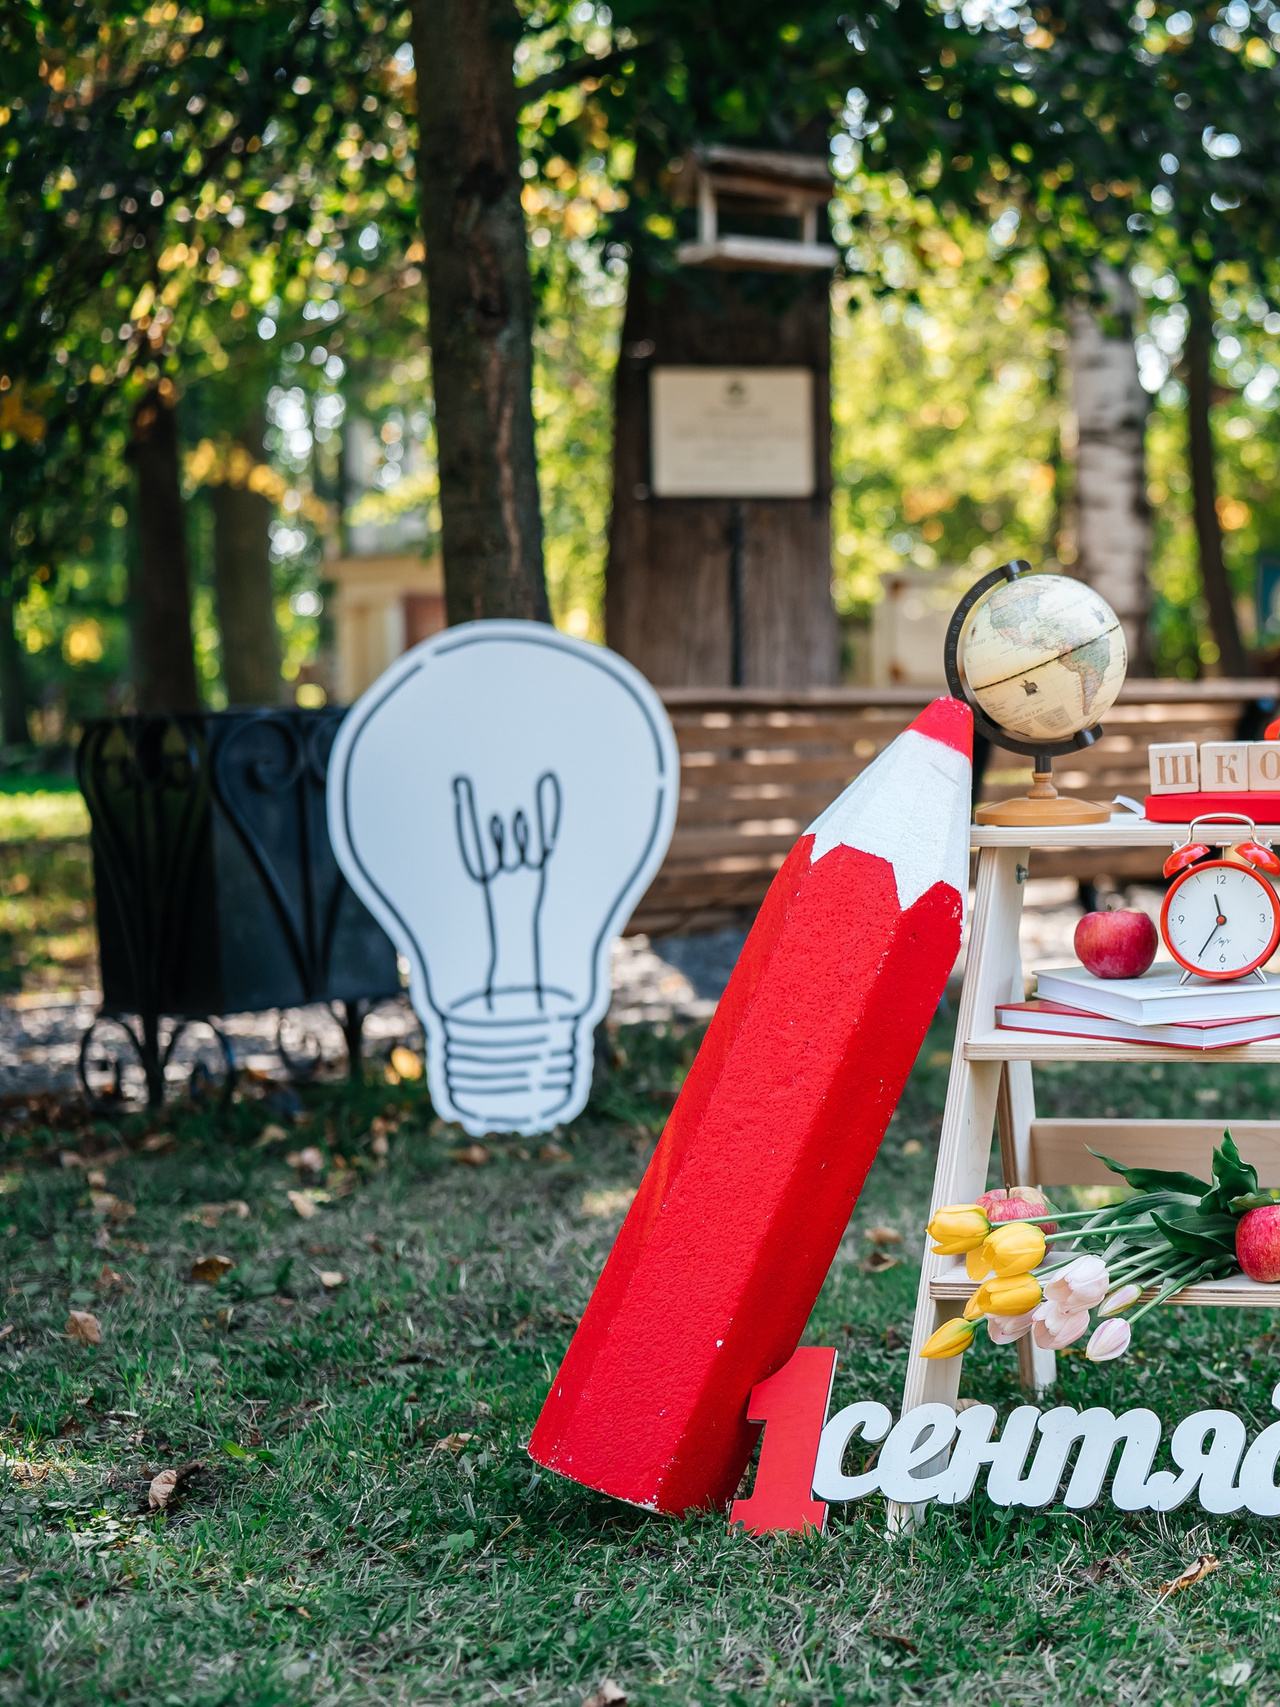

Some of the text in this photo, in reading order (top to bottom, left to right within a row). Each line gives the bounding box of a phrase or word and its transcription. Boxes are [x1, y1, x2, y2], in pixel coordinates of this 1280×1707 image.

[1216, 875, 1227, 885] 12
[1178, 915, 1185, 925] 9
[1259, 913, 1266, 923] 3
[1218, 953, 1226, 963] 6
[729, 1347, 838, 1538] 1
